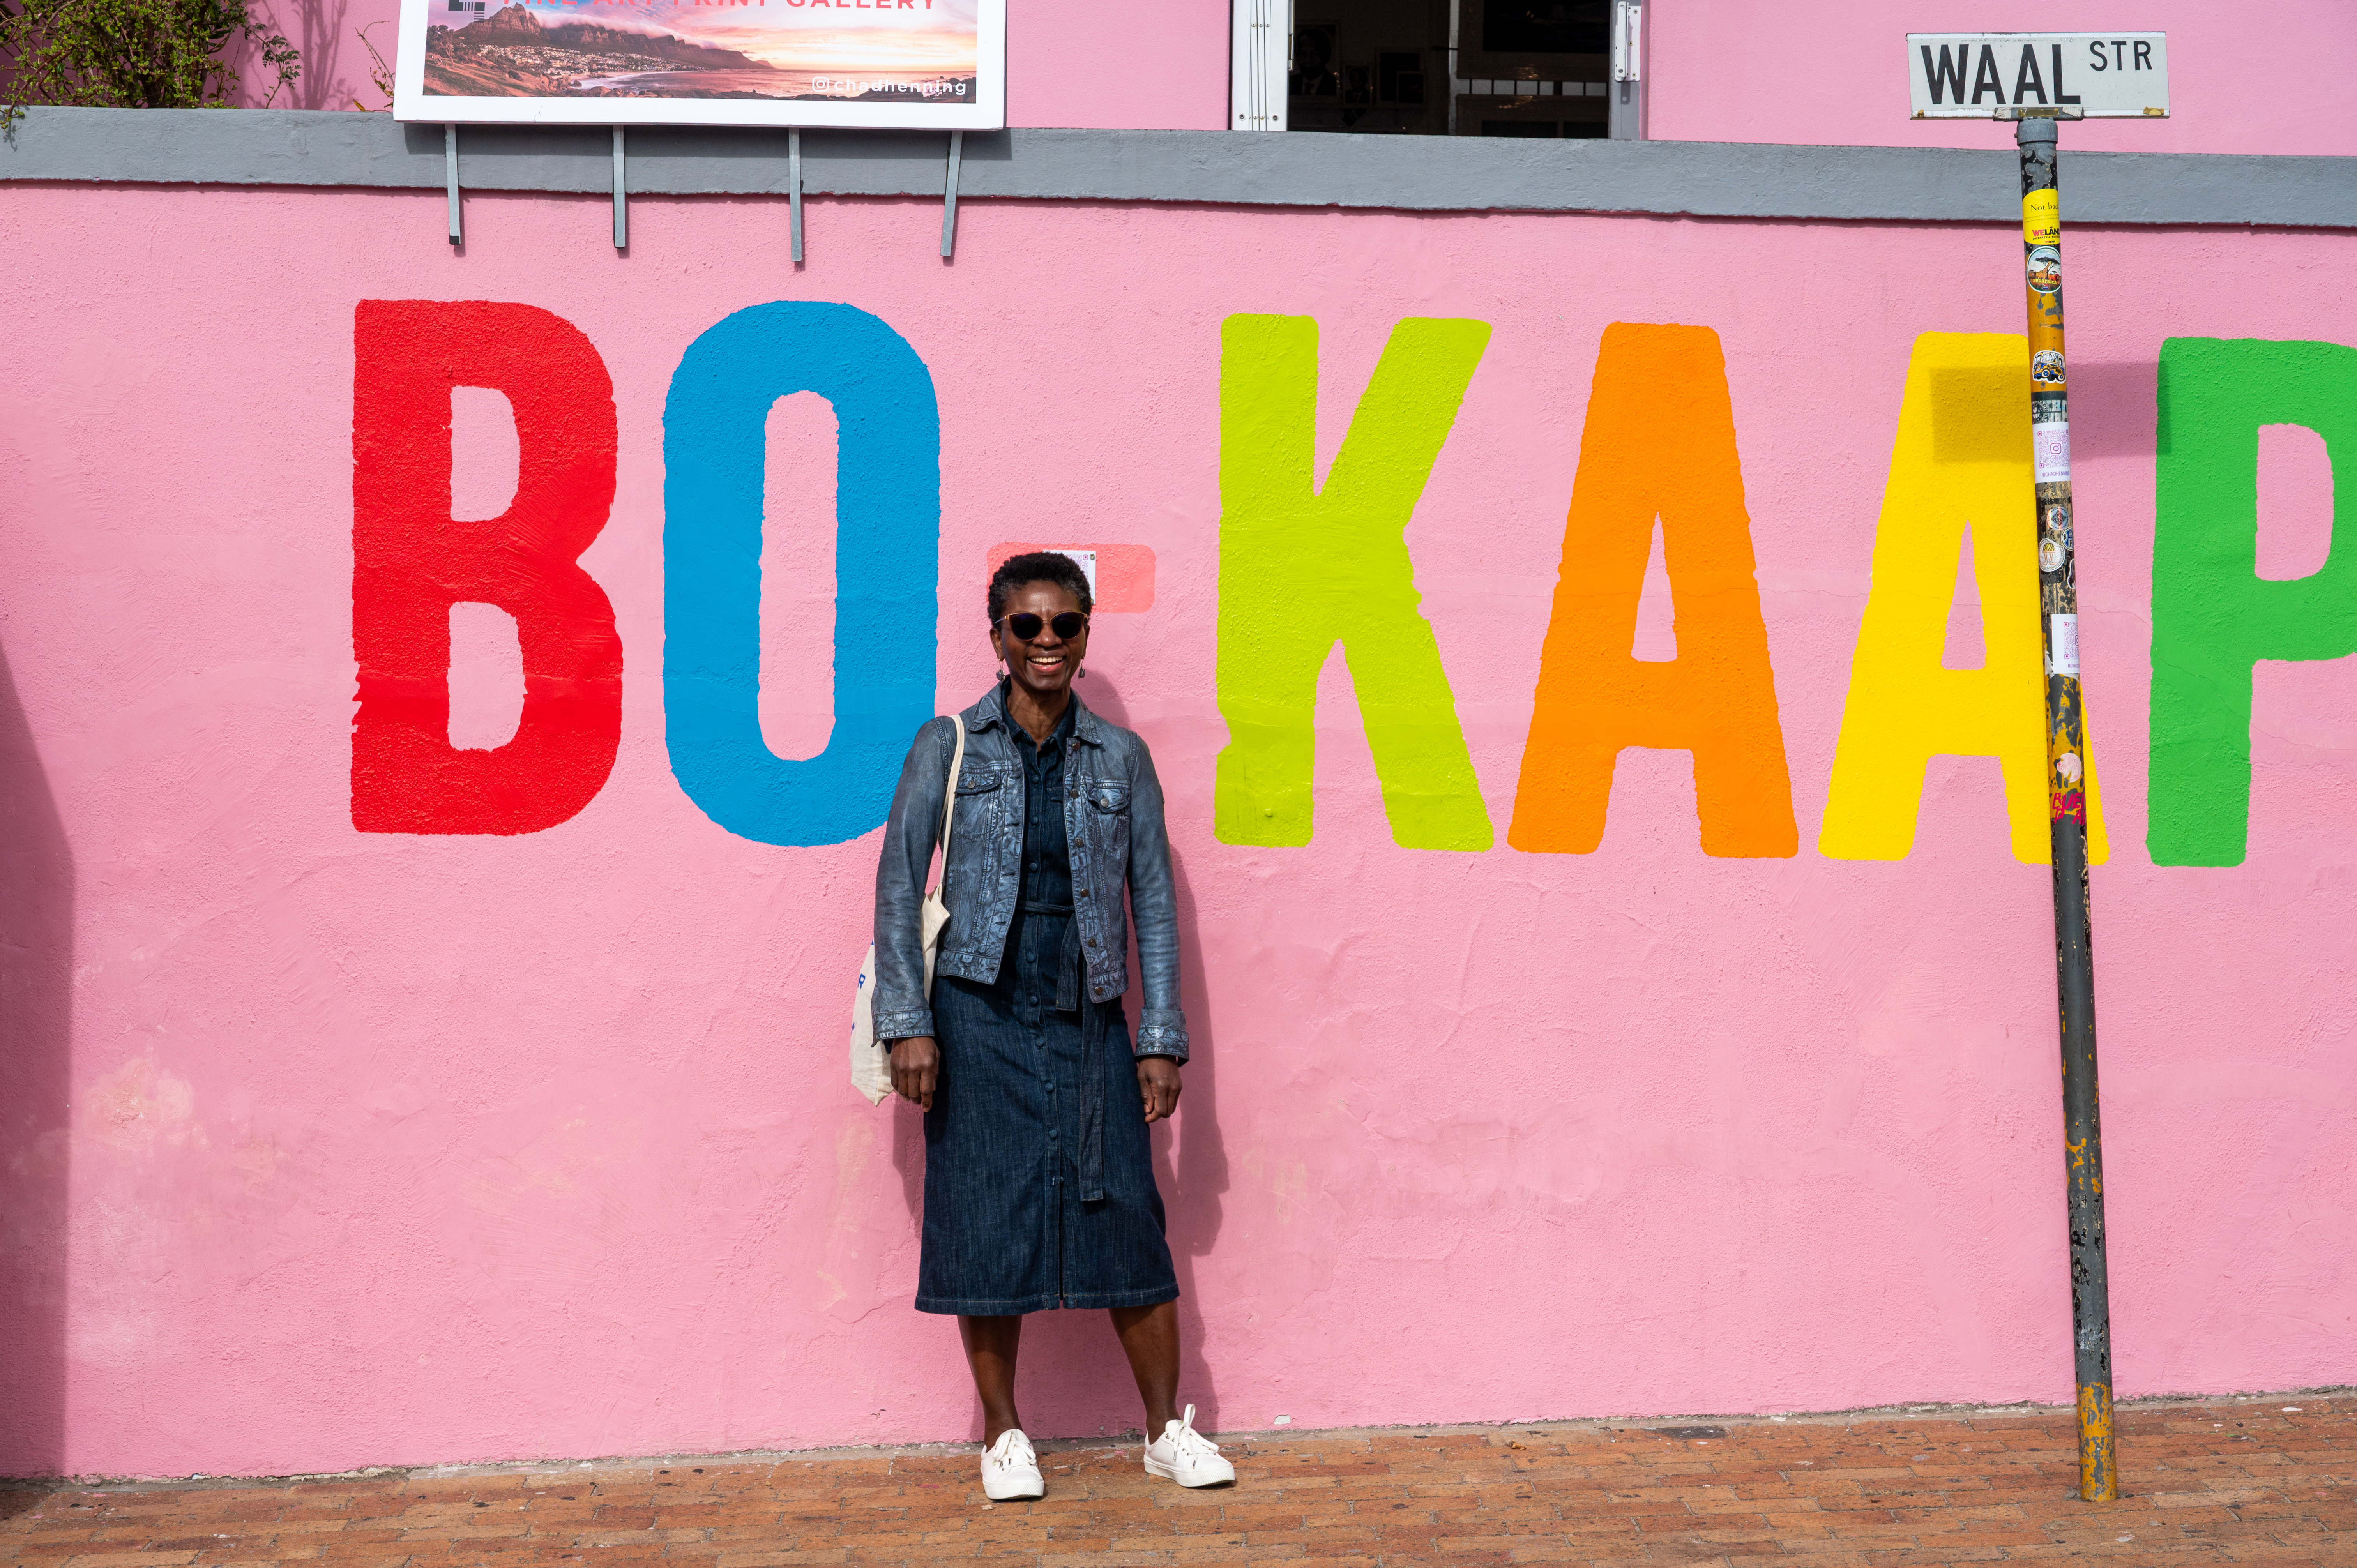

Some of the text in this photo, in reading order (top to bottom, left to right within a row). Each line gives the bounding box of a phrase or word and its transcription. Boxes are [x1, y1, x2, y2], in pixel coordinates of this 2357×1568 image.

[834, 78, 966, 95] chadhenning
[1920, 40, 2153, 104] WAAL STR
